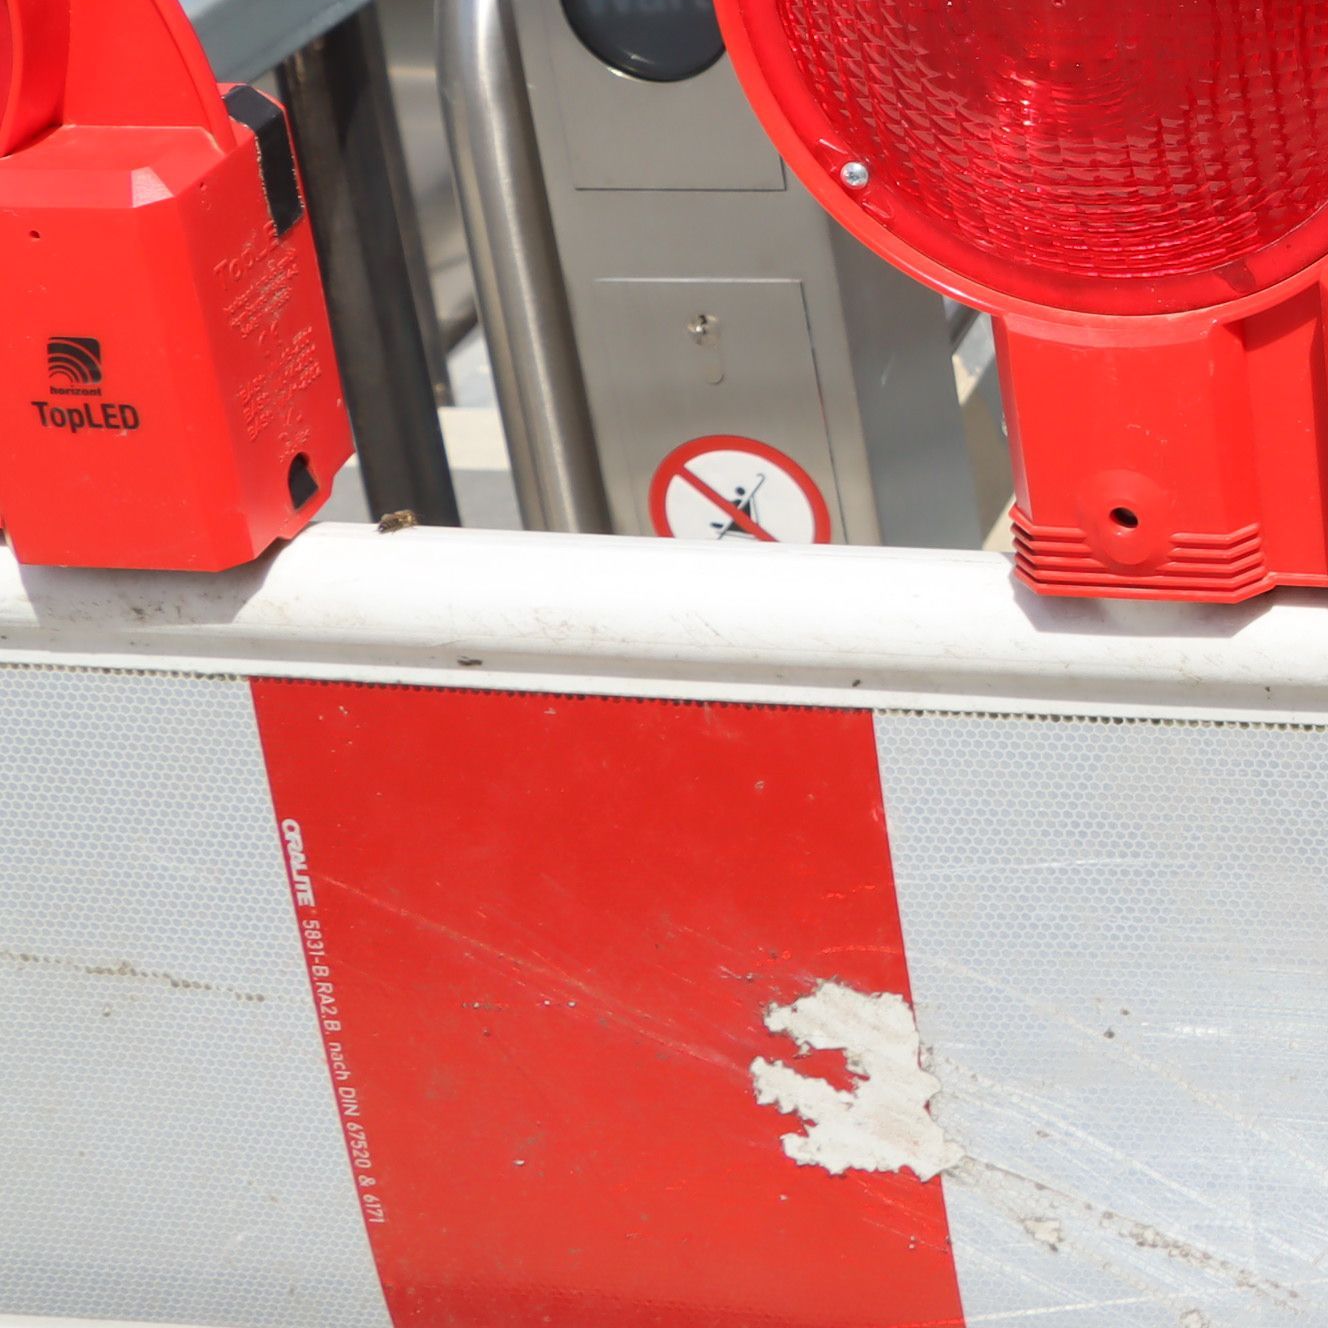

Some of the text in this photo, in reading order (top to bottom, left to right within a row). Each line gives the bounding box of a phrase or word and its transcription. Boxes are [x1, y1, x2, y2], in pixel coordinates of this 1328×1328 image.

[31, 401, 141, 433] TopLED
[328, 1042, 351, 1082] nach
[339, 1085, 361, 1118] DIN
[347, 1121, 371, 1170] 67520
[358, 1174, 377, 1188] &
[363, 1193, 386, 1224] 6171
